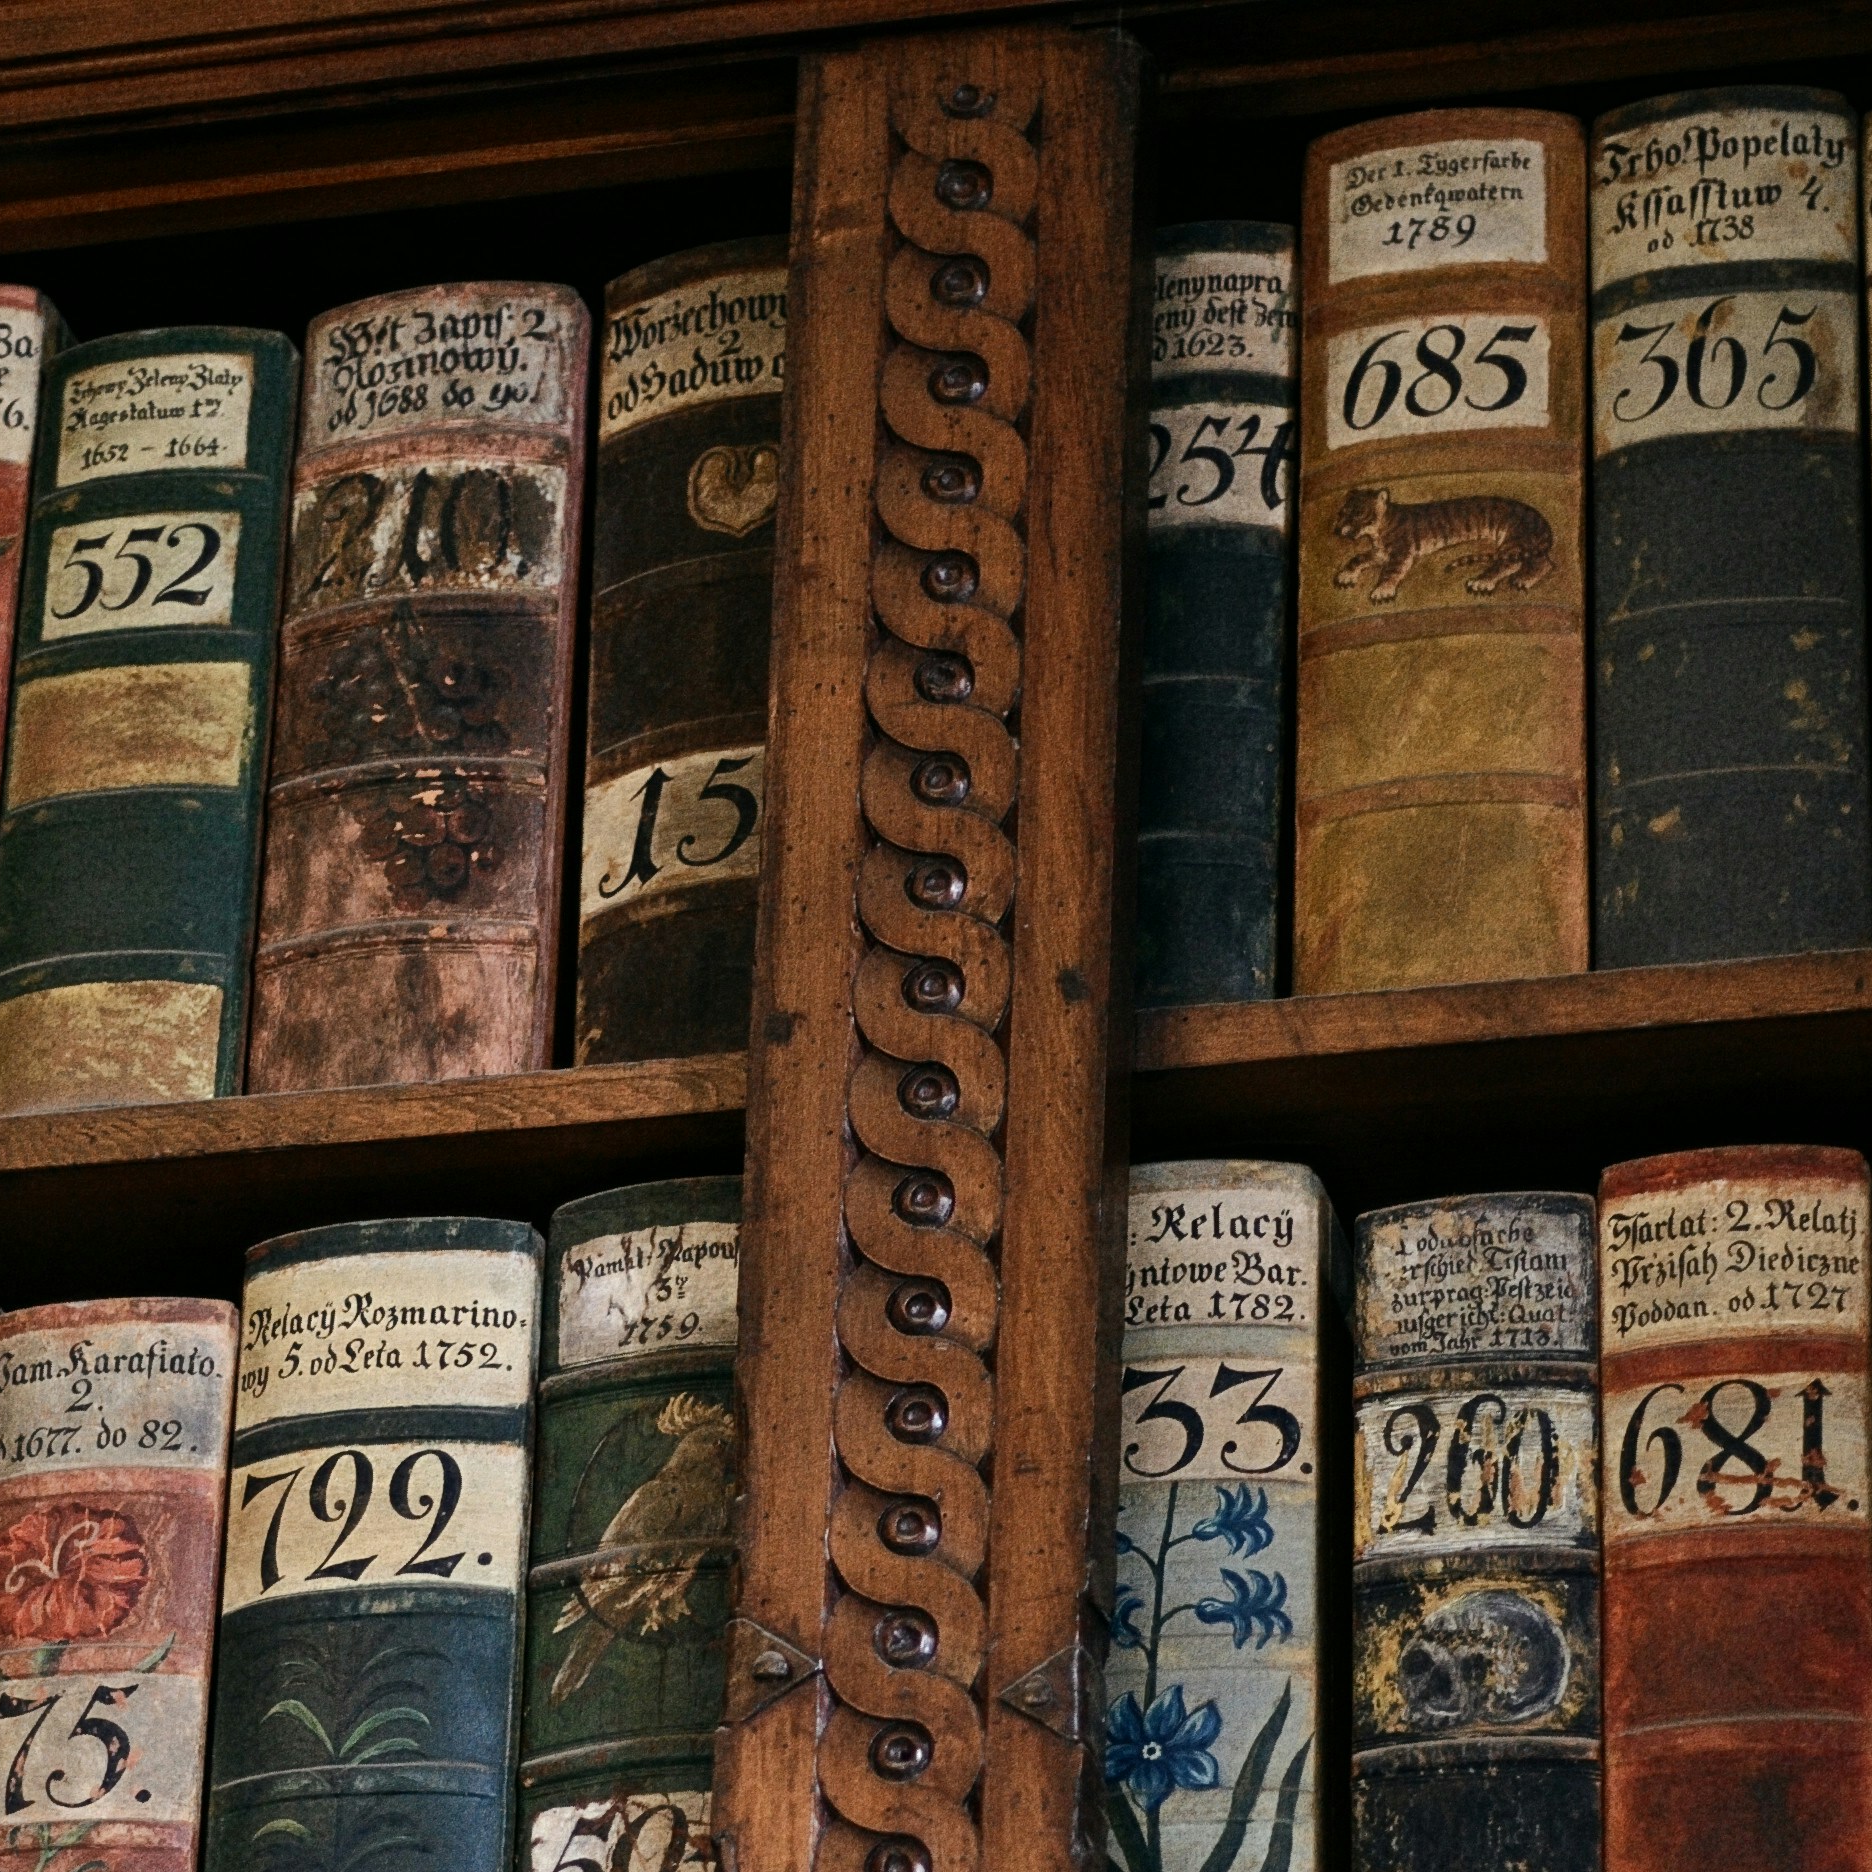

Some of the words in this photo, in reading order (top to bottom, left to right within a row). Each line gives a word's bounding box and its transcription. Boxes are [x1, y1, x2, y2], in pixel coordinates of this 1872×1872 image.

[1381, 212, 1477, 250] 1789
[1342, 324, 1539, 432] 685
[1612, 295, 1818, 423] 365
[51, 521, 223, 621] 552
[1726, 1199, 1765, 1234] 2.
[1207, 1291, 1307, 1322] 1782.
[1728, 1289, 1756, 1316] od
[1760, 1281, 1847, 1313] 1727
[277, 1343, 306, 1381] 5.
[413, 1339, 514, 1373] 1752.
[65, 1377, 106, 1415] 2.
[10, 1424, 84, 1463] 1677.
[95, 1416, 127, 1449] do
[136, 1417, 200, 1454] 82.
[1121, 1361, 1314, 1479] 33.
[1618, 1377, 1859, 1518] 681.
[241, 1448, 494, 1596] 722.
